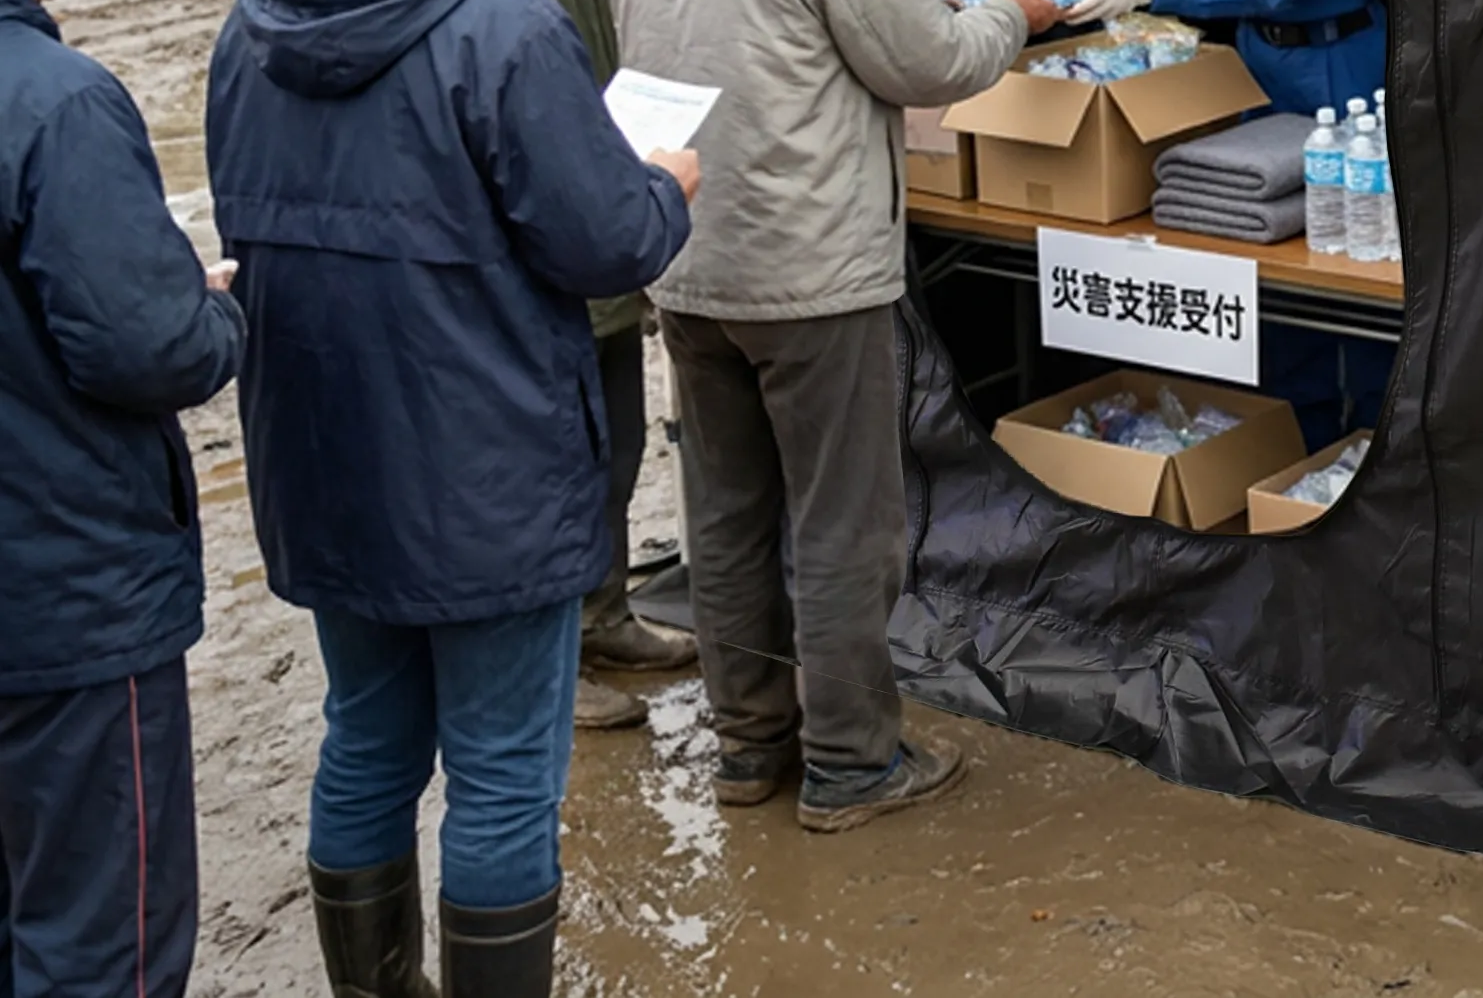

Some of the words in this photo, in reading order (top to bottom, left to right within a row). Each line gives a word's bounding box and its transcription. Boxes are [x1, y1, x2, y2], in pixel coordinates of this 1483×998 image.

[1051, 265, 1246, 341] 災害支援受付
